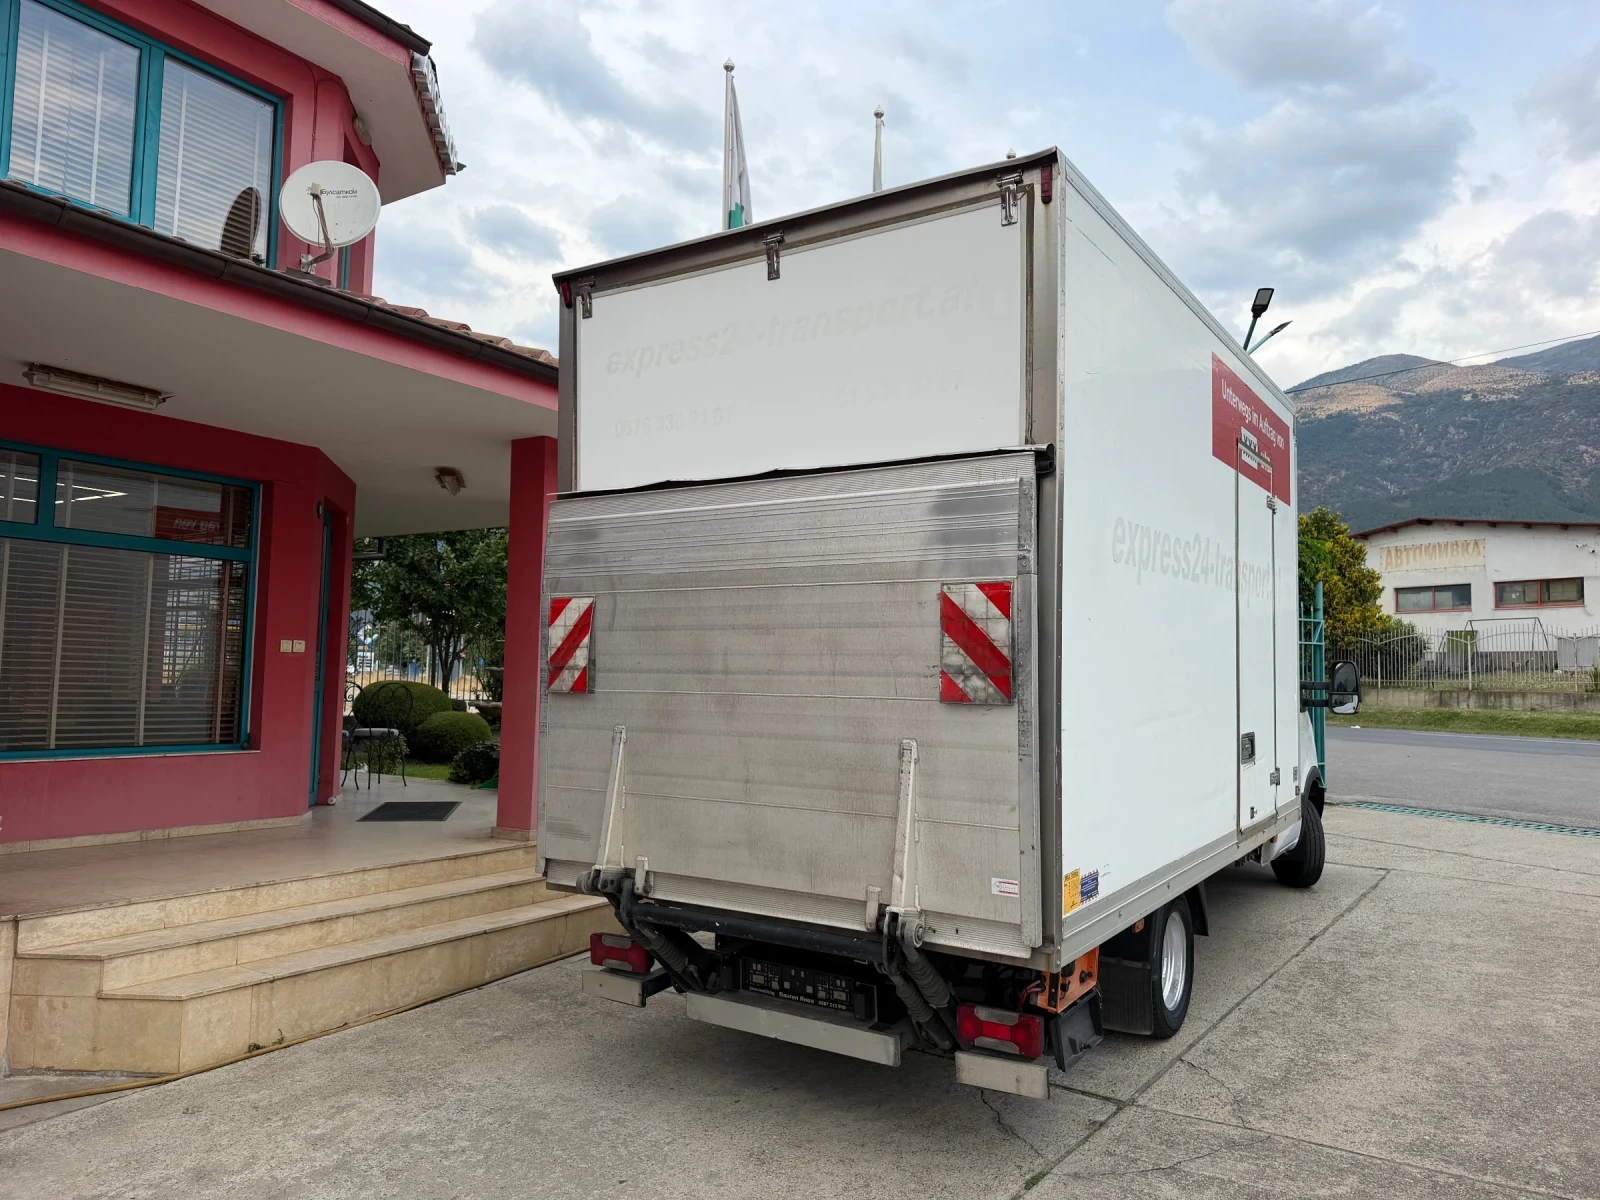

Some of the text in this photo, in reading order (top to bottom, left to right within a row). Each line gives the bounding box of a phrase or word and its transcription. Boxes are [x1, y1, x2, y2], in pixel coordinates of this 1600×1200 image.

[1221, 379, 1251, 423] Unterwegs
[1259, 414, 1277, 447] Auftrag
[1385, 541, 1482, 570] АВТОМИВКА
